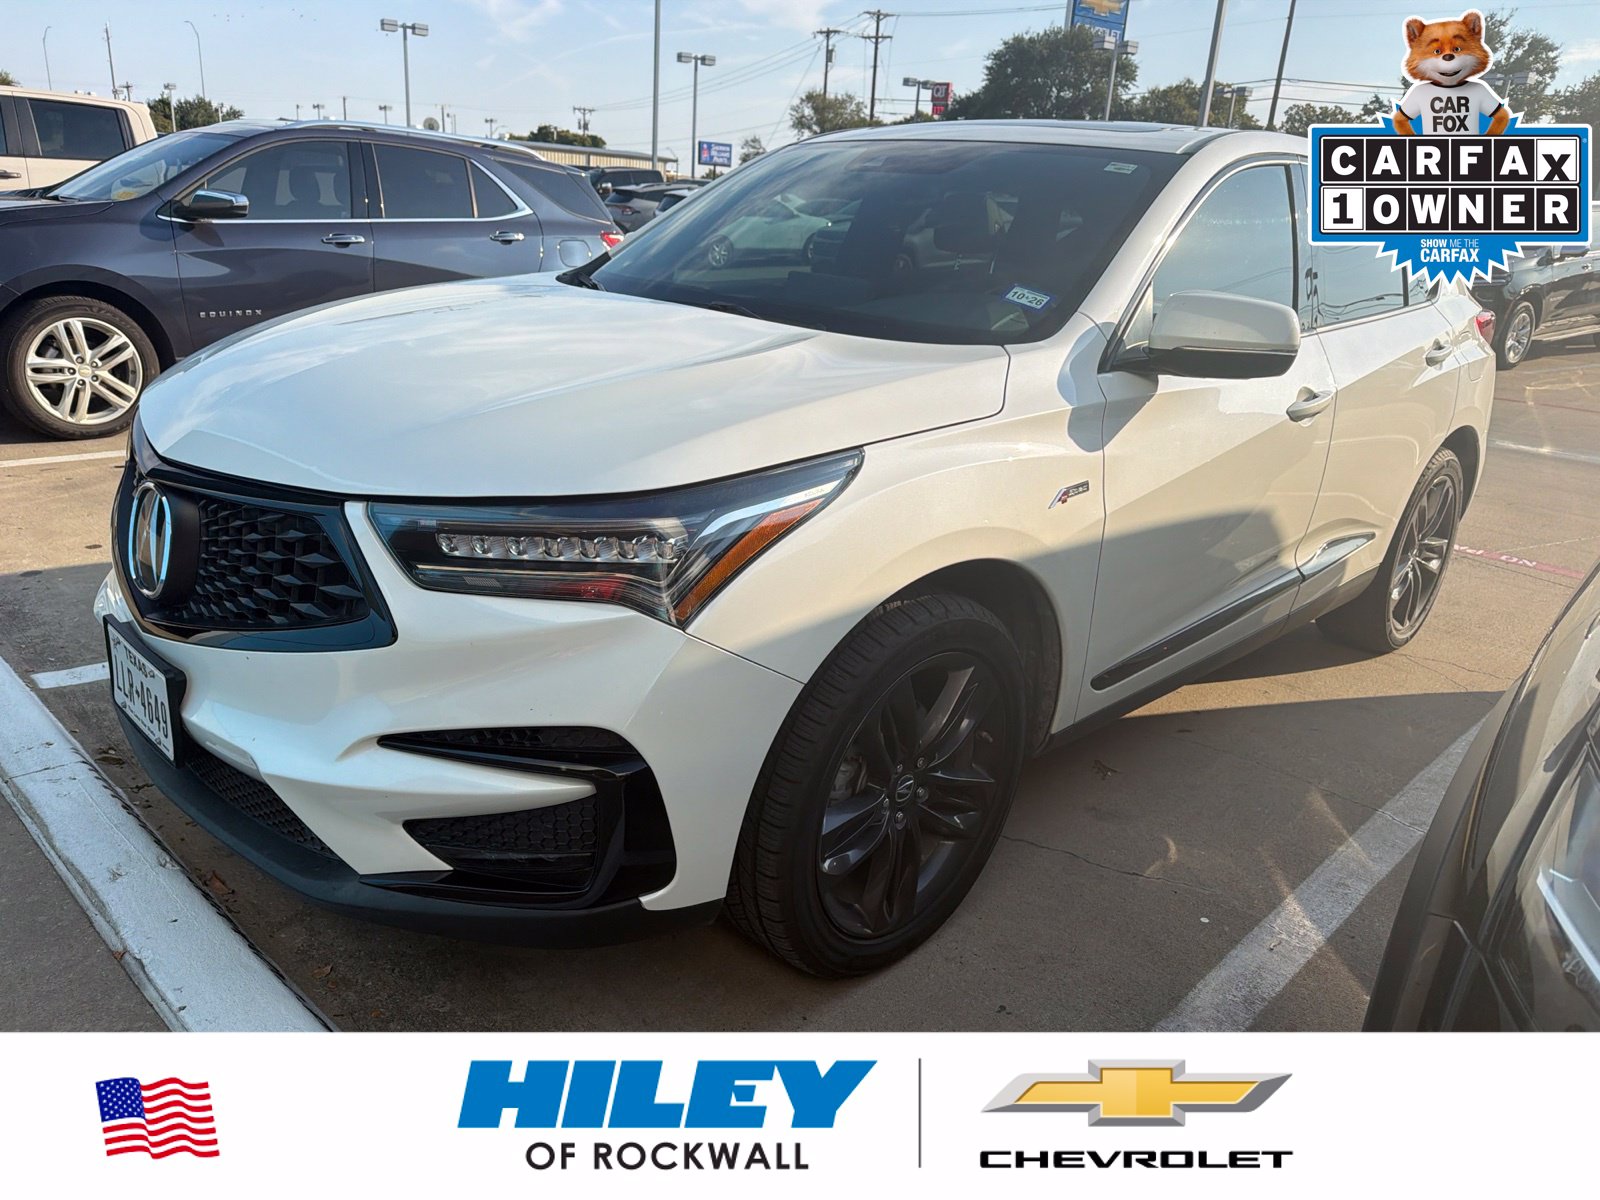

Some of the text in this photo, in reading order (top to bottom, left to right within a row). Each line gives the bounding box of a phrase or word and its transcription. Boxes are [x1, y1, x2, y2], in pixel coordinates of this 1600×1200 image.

[933, 85, 947, 97] QT
[199, 309, 262, 318] EQUINOX
[123, 645, 149, 679] TEXAS
